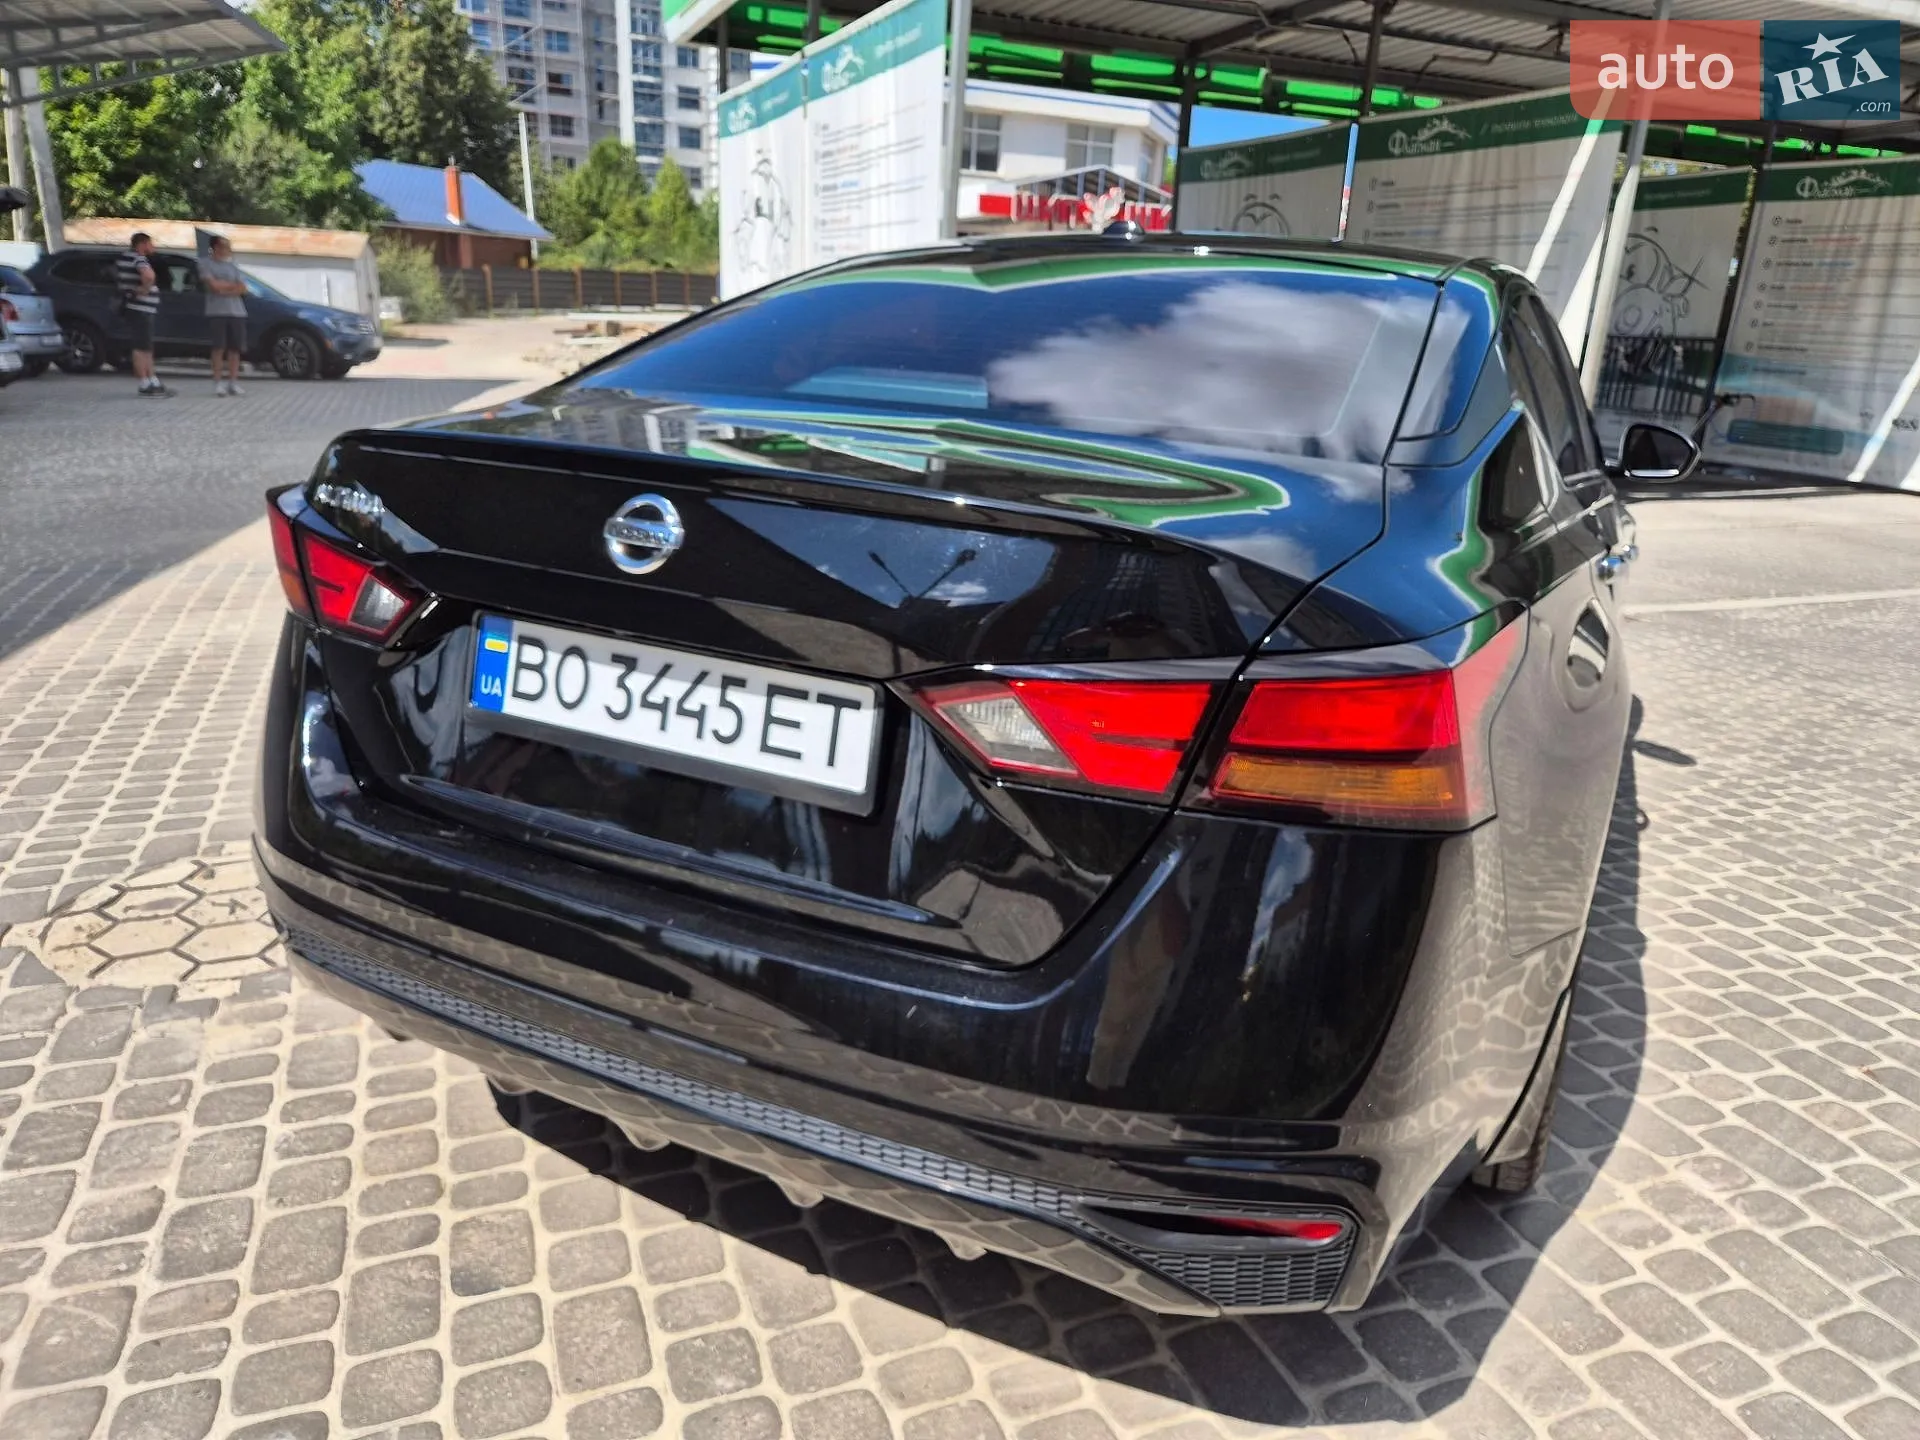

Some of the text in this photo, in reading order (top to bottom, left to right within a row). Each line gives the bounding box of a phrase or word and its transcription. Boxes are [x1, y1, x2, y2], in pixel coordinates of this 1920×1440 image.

[480, 673, 502, 697] UA
[512, 634, 863, 767] BO 3445 ET
